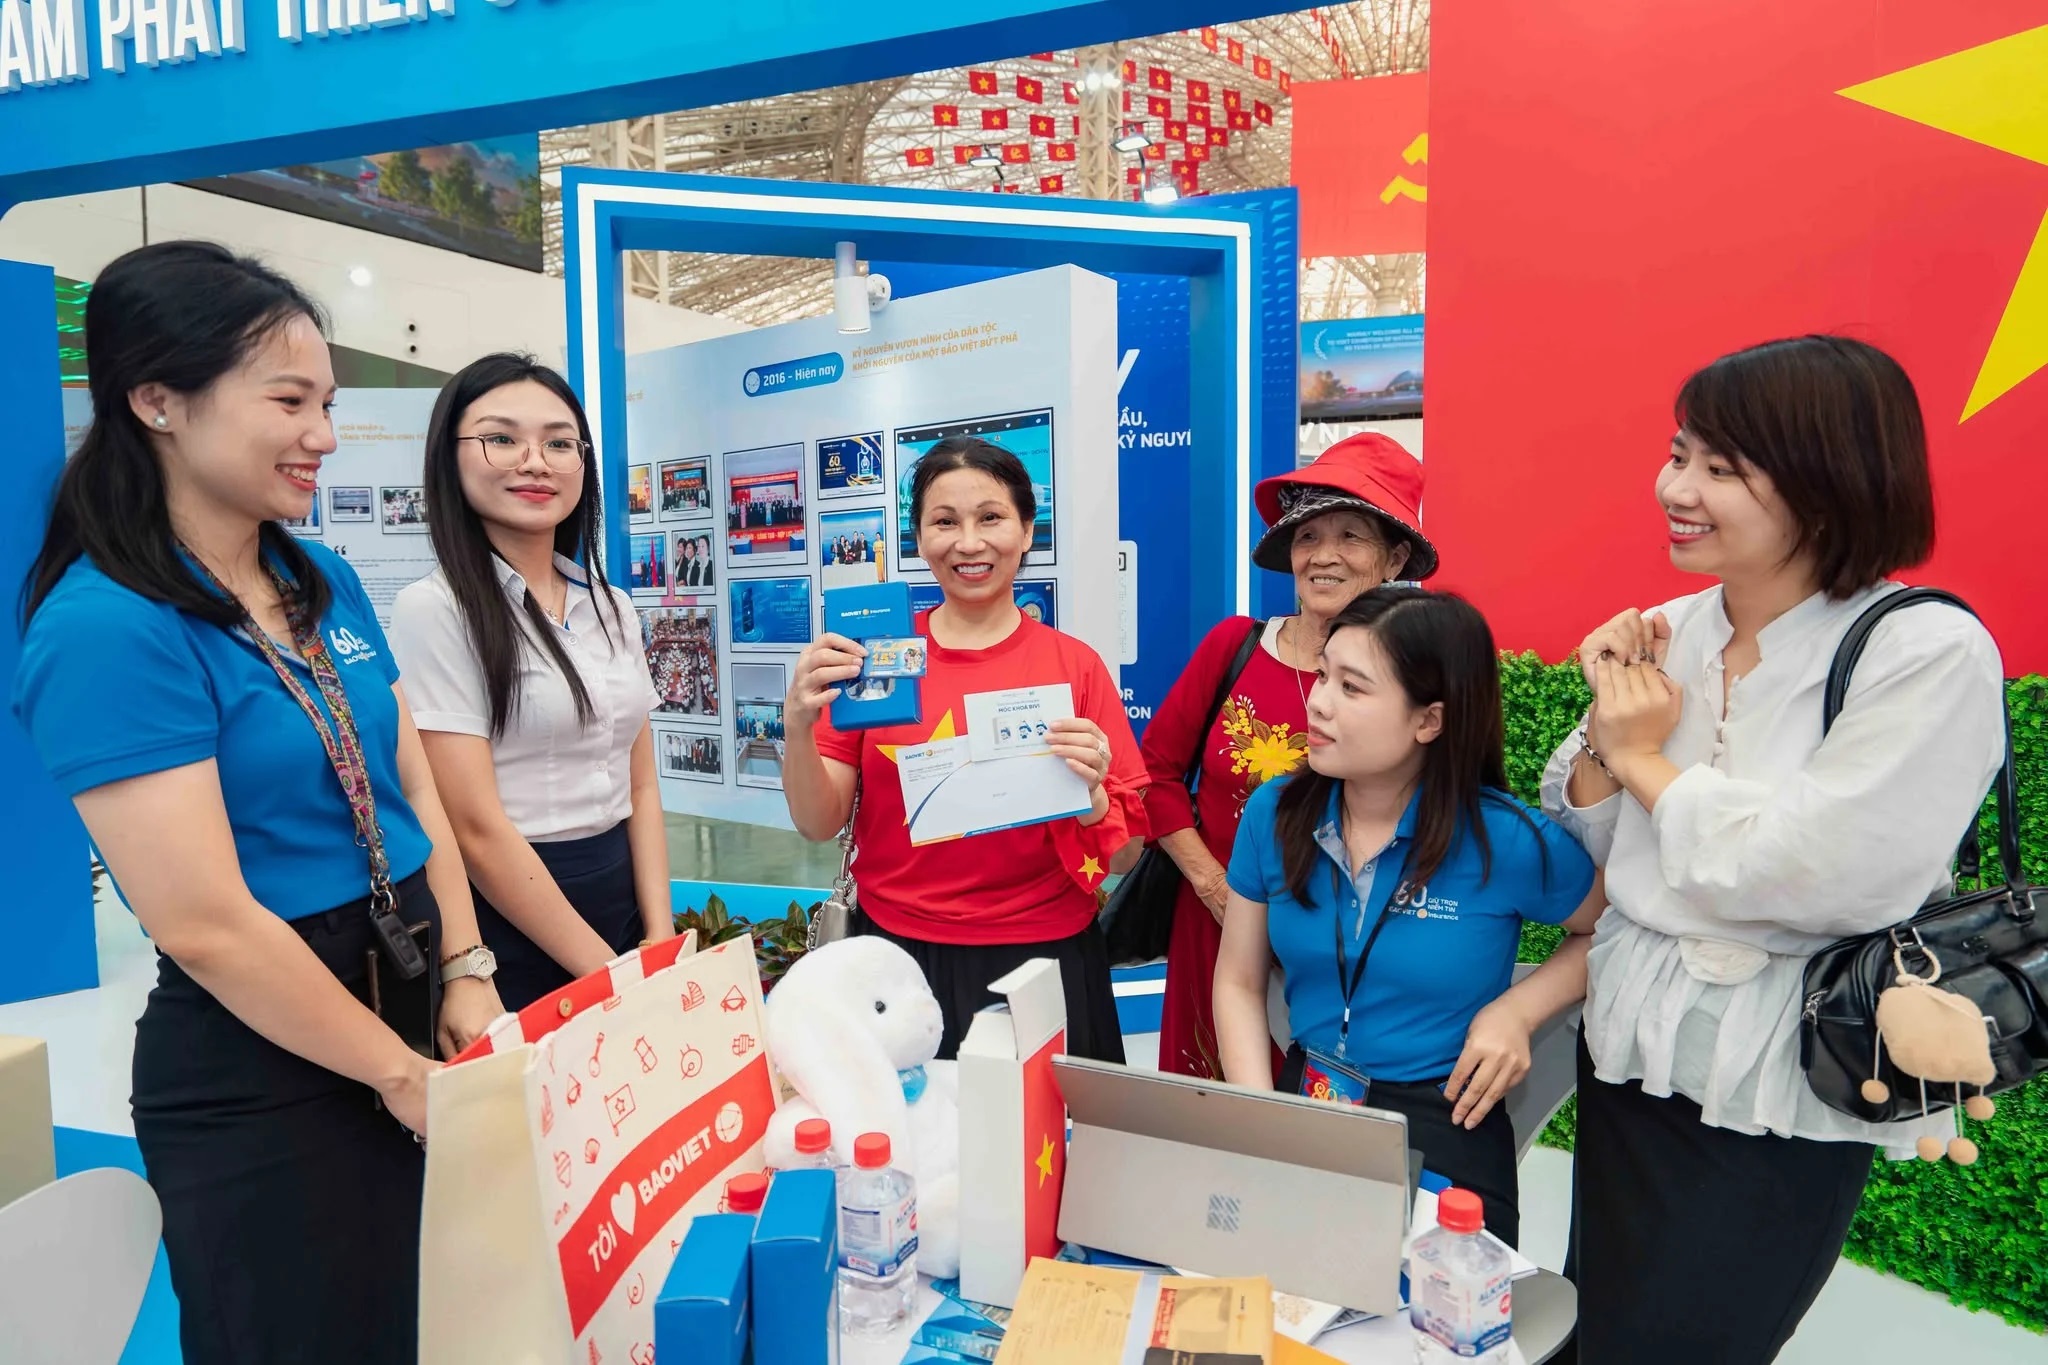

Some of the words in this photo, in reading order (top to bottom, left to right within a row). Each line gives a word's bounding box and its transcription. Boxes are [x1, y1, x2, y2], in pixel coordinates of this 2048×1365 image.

[943, 328, 959, 341] CỦA
[960, 339, 978, 353] VIỆT
[763, 372, 786, 387] 2016
[818, 365, 837, 377] nay
[1118, 406, 1148, 428] ẦU,
[330, 627, 360, 655] 60
[588, 1221, 617, 1273] TÔI
[637, 1126, 711, 1206] BAOVIET
